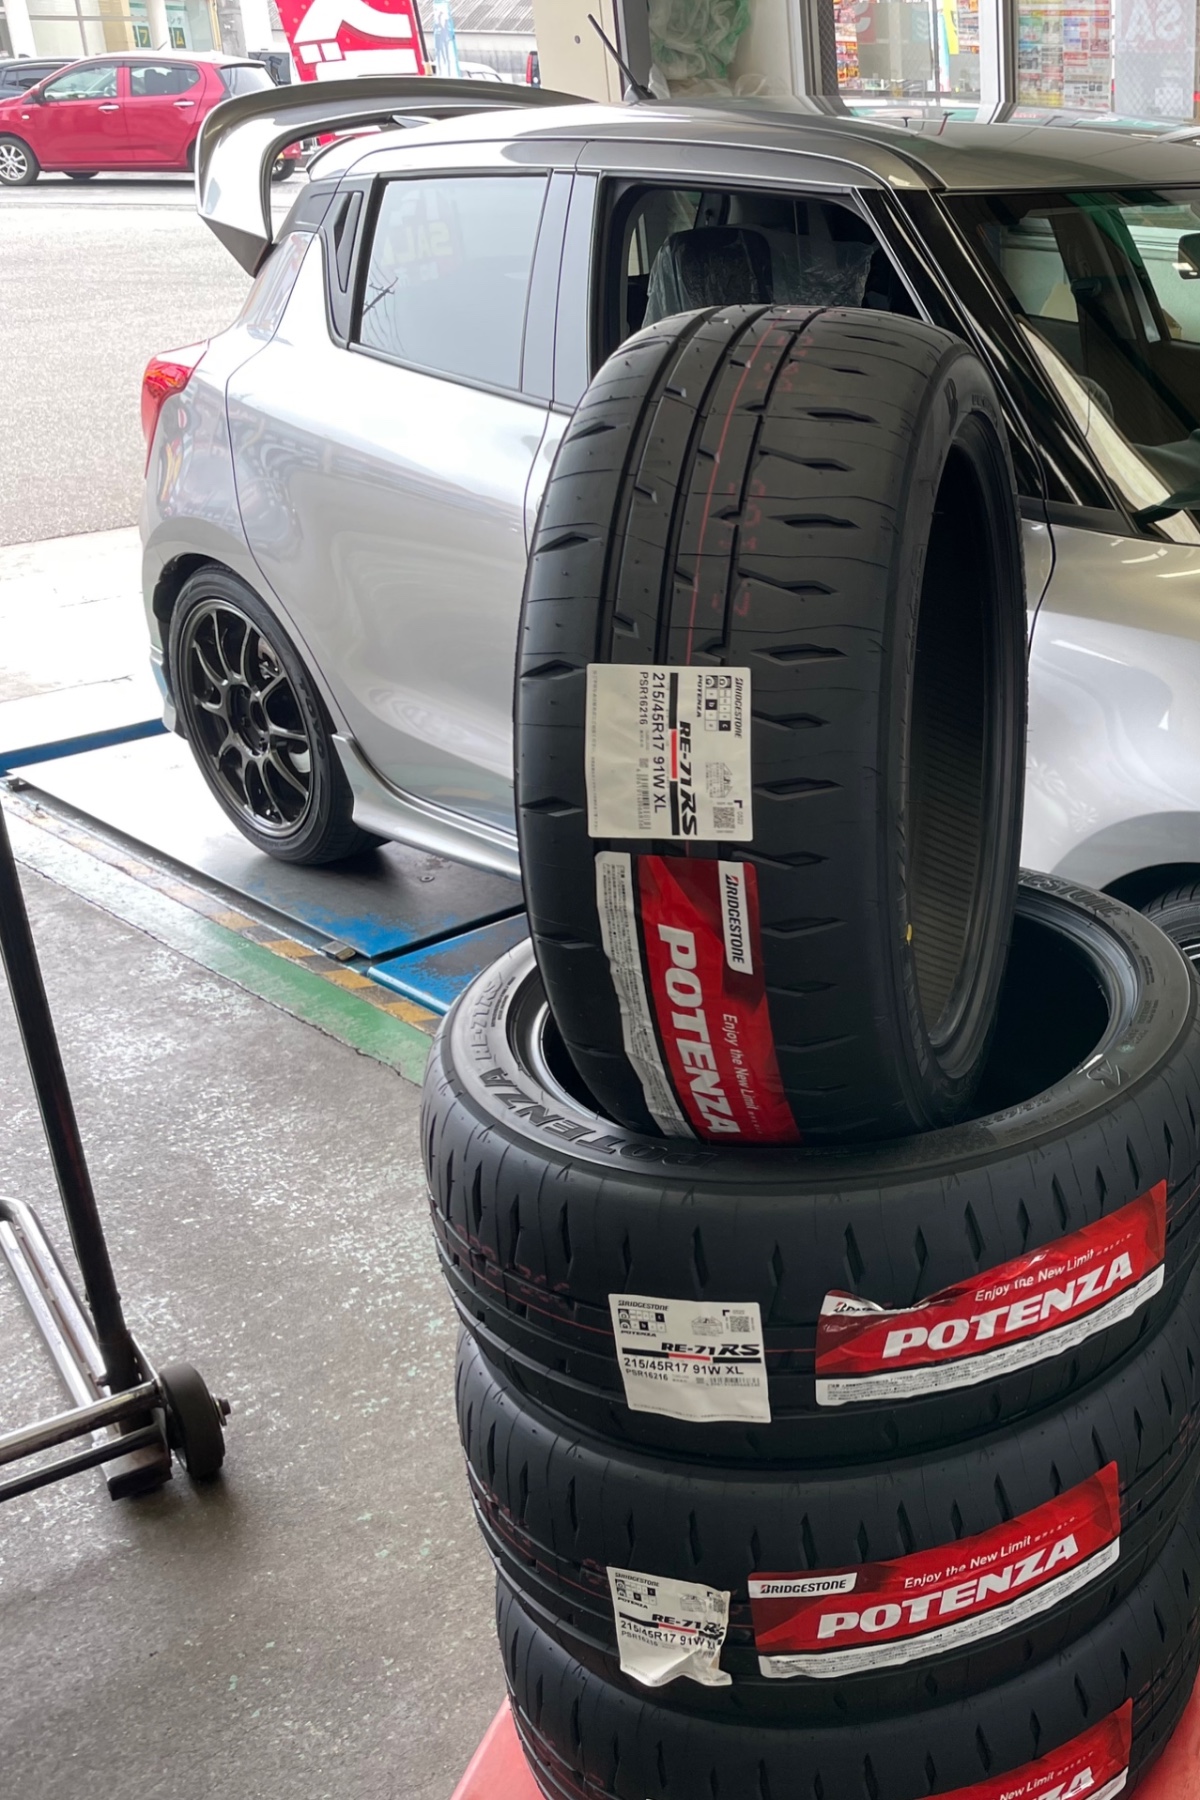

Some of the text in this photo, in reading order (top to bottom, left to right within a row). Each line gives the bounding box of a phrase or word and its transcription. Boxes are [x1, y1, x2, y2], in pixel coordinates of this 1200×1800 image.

[639, 671, 649, 725] PSR16216
[734, 677, 744, 739] BRIDGESTONE
[652, 673, 667, 814] 215/45R17 91W XL
[725, 873, 745, 964] BRIDGESTONE
[657, 923, 741, 1134] POTENZA
[723, 1013, 756, 1112] Enjoy the New Limit
[479, 1066, 717, 1167] POTENZA
[975, 1284, 1010, 1303] Enjoy
[1037, 1264, 1065, 1282] New
[1067, 1248, 1095, 1271] Limit
[618, 1300, 669, 1311] BRIDGESTONE
[882, 1251, 1133, 1359] POTENZA
[624, 1357, 744, 1375] 215/45R17 91W XL
[625, 1369, 669, 1381] PSR16216
[760, 1579, 847, 1595] BRIDGESTONE
[816, 1533, 1079, 1639] POTENZA
[904, 1534, 1031, 1590] Enjoy the New Limit
[621, 1620, 676, 1643] 215/45R17
[1000, 1785, 1026, 1800] New
[1026, 1771, 1055, 1793] Limit
